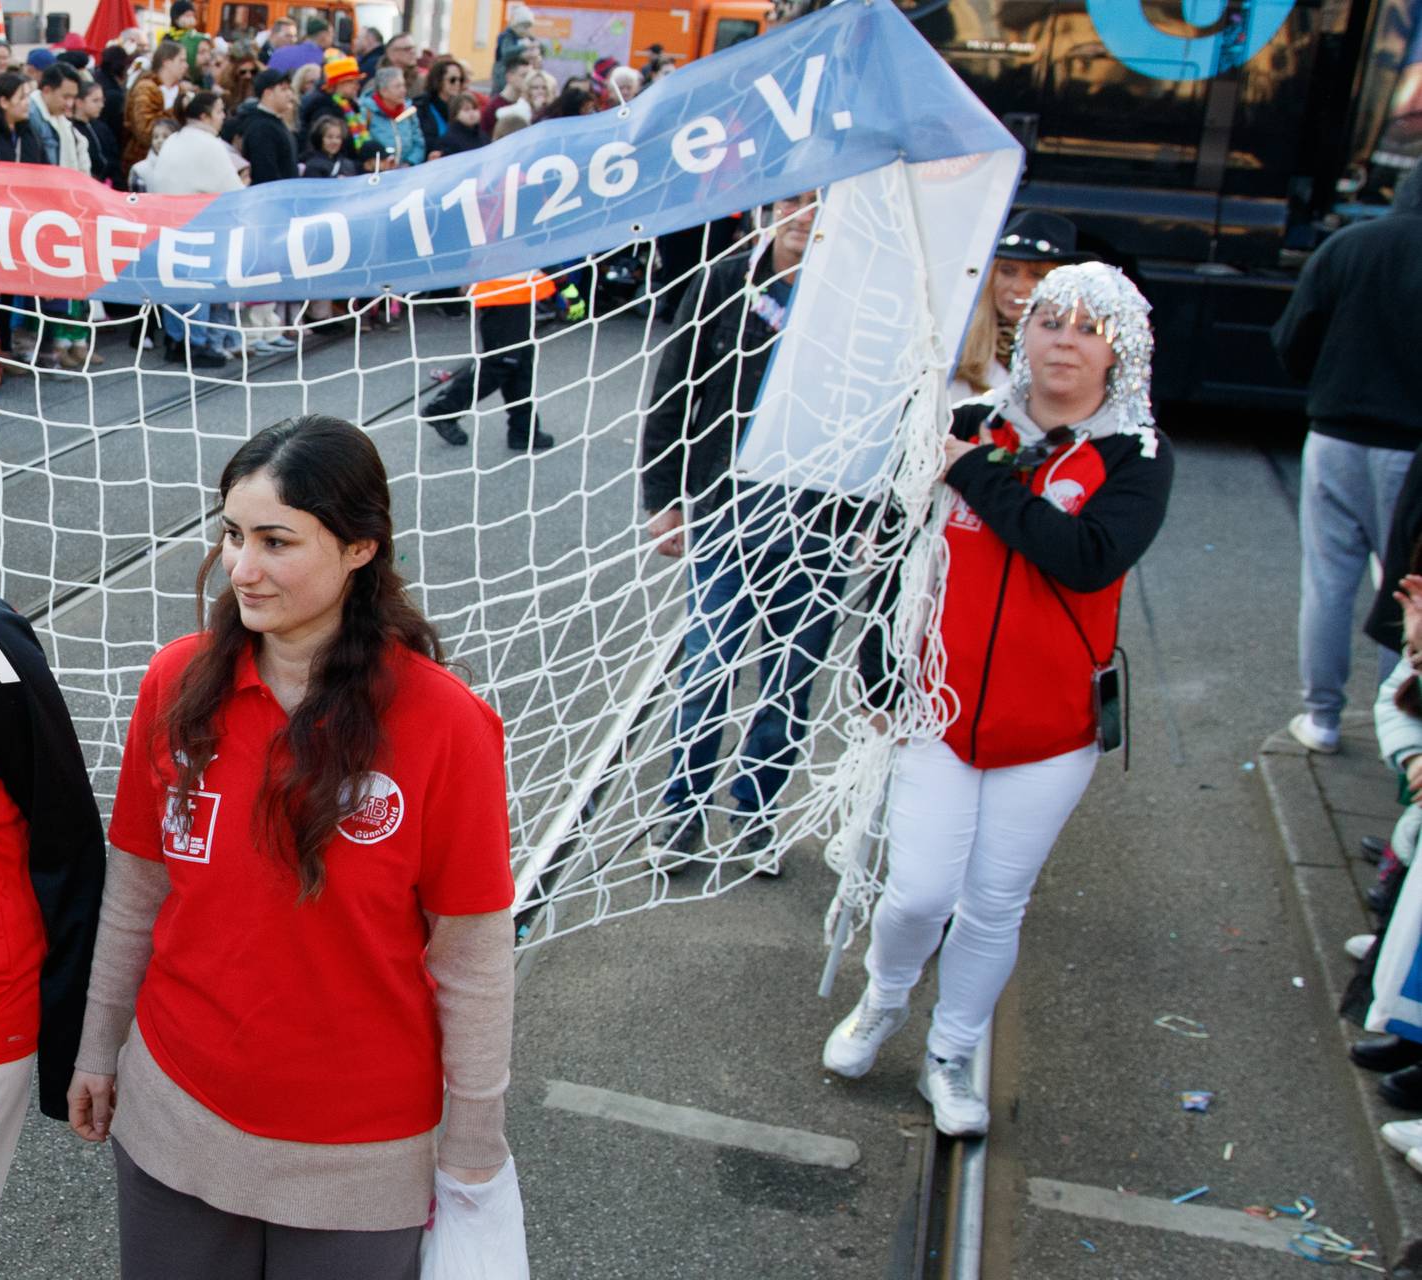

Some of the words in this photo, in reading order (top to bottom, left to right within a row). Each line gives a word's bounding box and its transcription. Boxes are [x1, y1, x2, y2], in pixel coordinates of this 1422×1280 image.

[389, 142, 638, 257] 11/26
[672, 55, 853, 173] e.V.
[355, 807, 399, 838] Günnigfeld
